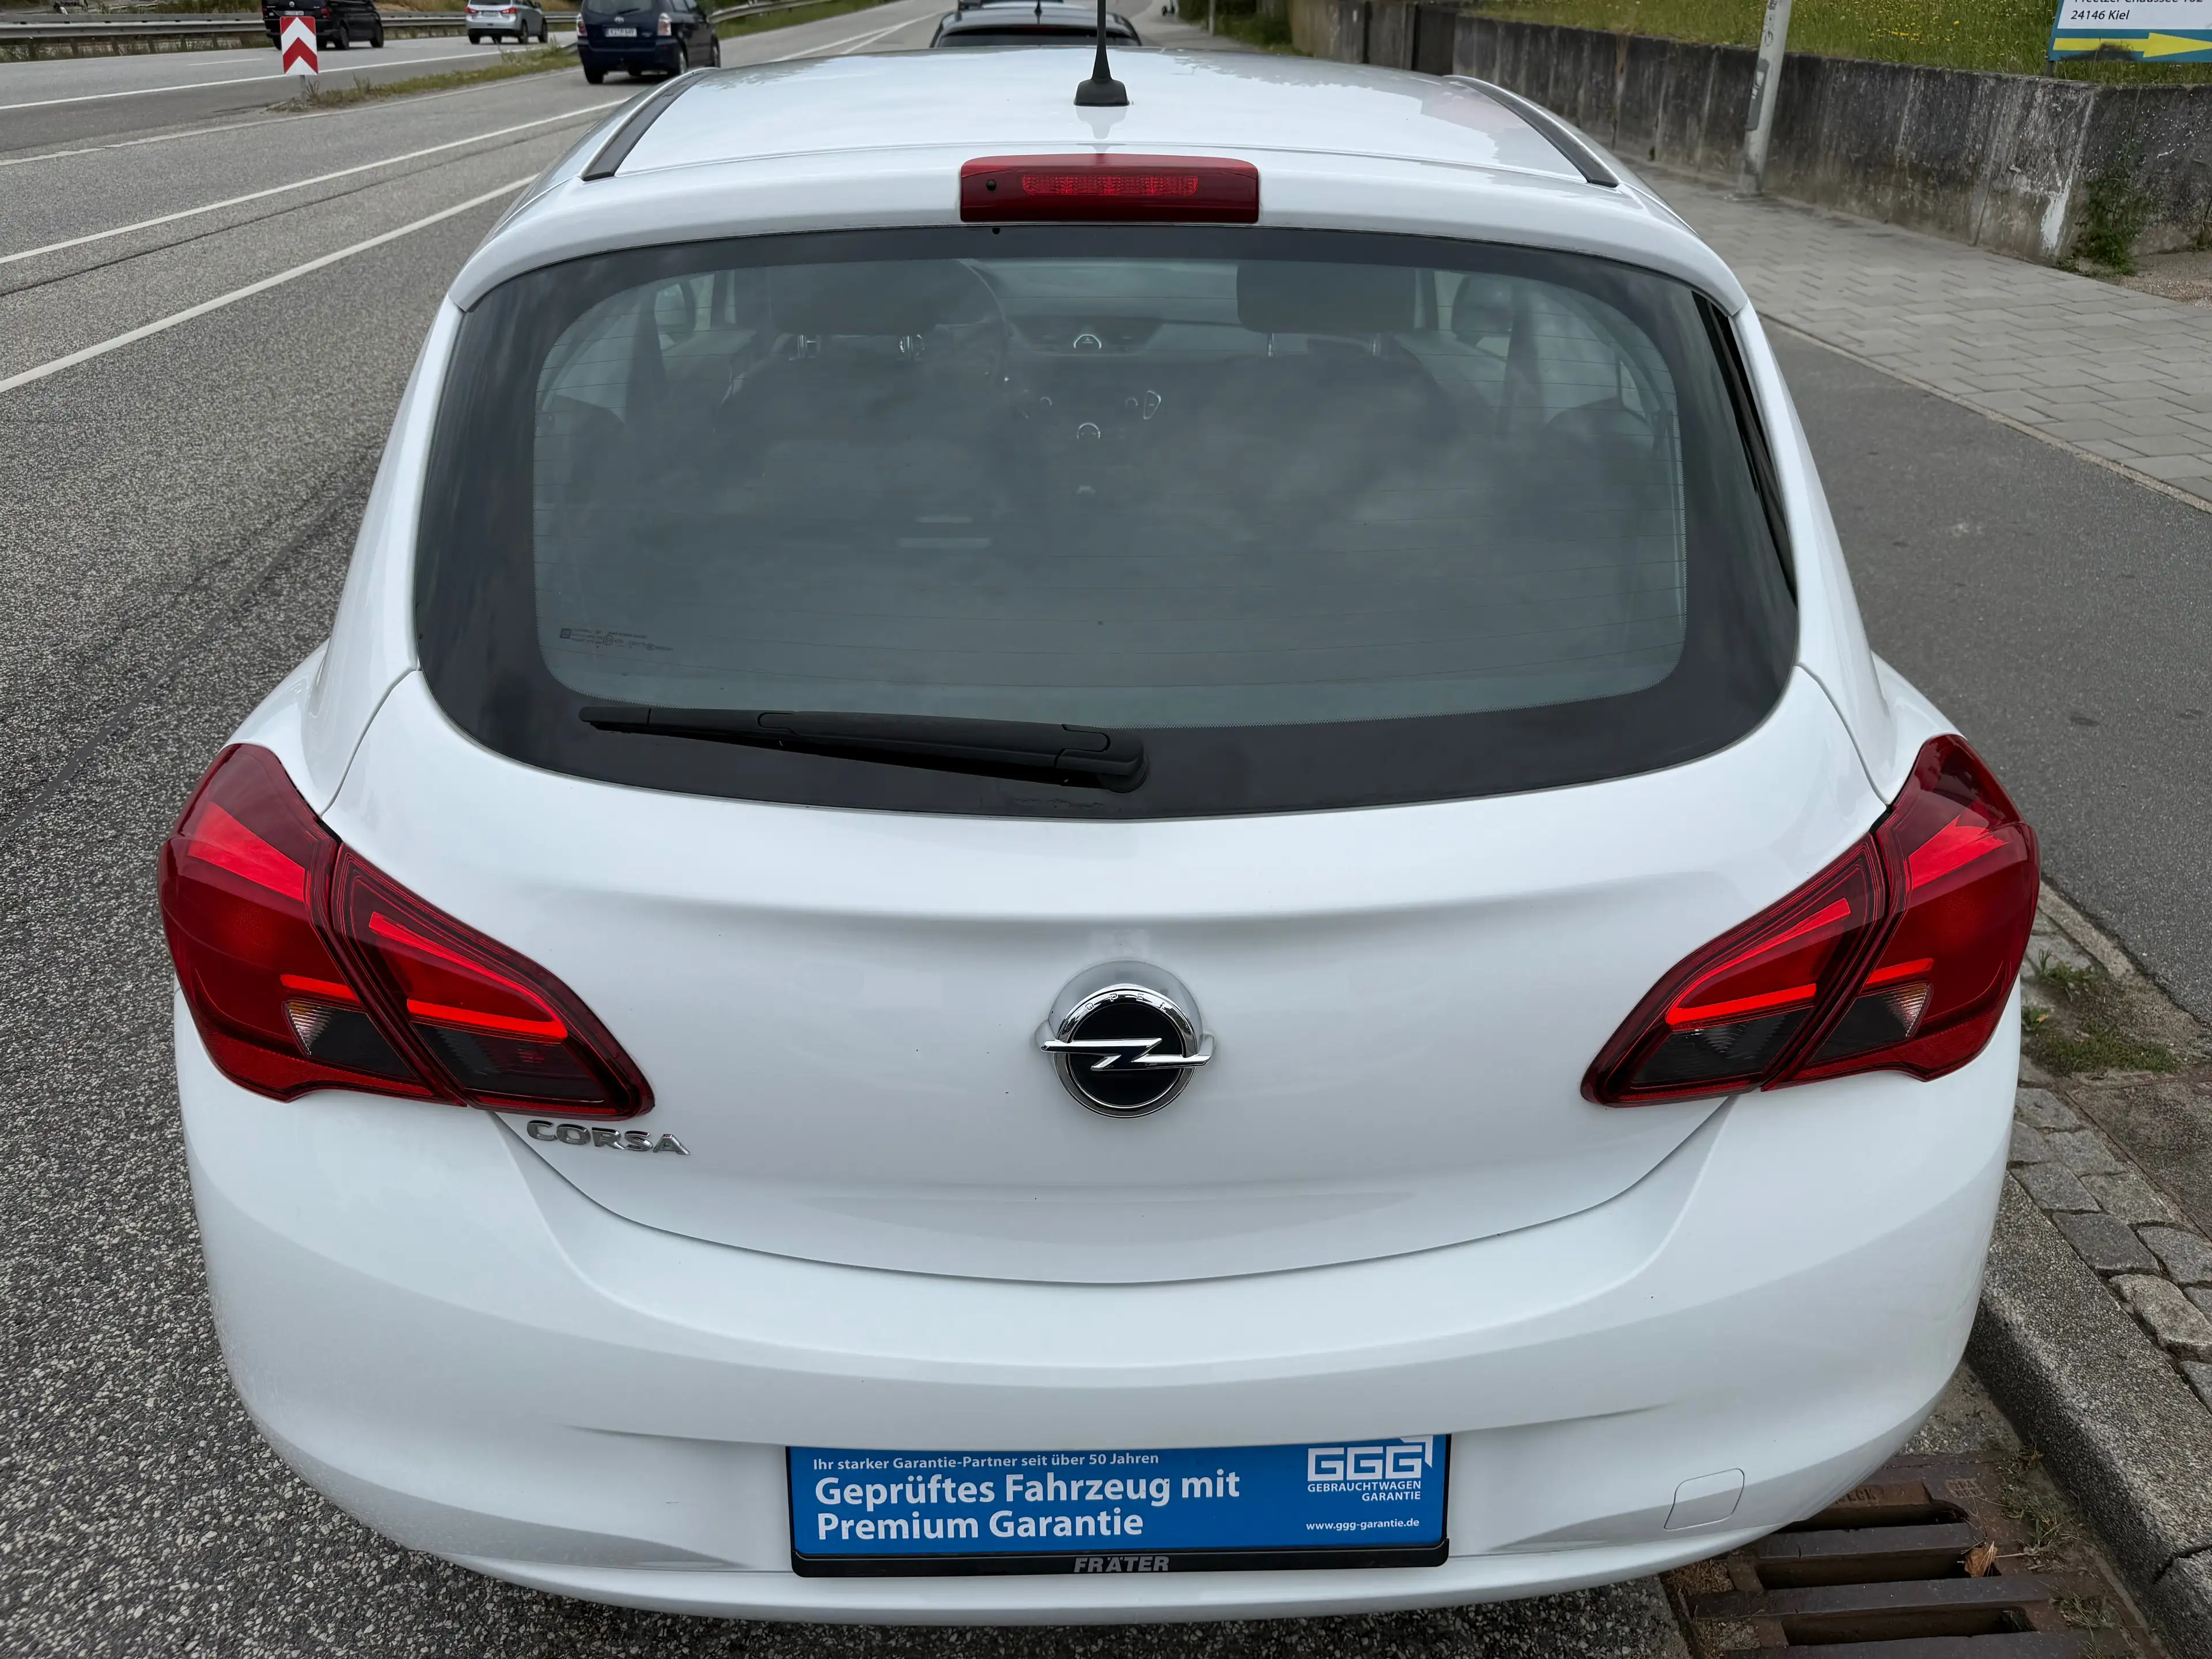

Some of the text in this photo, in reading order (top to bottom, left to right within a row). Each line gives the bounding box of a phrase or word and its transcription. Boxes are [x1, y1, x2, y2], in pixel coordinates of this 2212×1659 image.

[2070, 9, 2130, 20] 24146 Kiel
[527, 1119, 691, 1156] CORSA
[813, 1452, 1160, 1469] Ihr starker Garantie-Partner seit über 50 Jahren
[1307, 1445, 1422, 1482] GGG
[815, 1468, 1240, 1512] Geprüftes Fahrzeug mit
[1307, 1480, 1422, 1493] GEBRAUCHTWAGEN
[1361, 1491, 1421, 1502] GARANTIE
[817, 1507, 1144, 1540] Premium Garantie
[1306, 1517, 1420, 1531] www.ggg-garantie.de
[1074, 1555, 1170, 1573] FRÄTER
